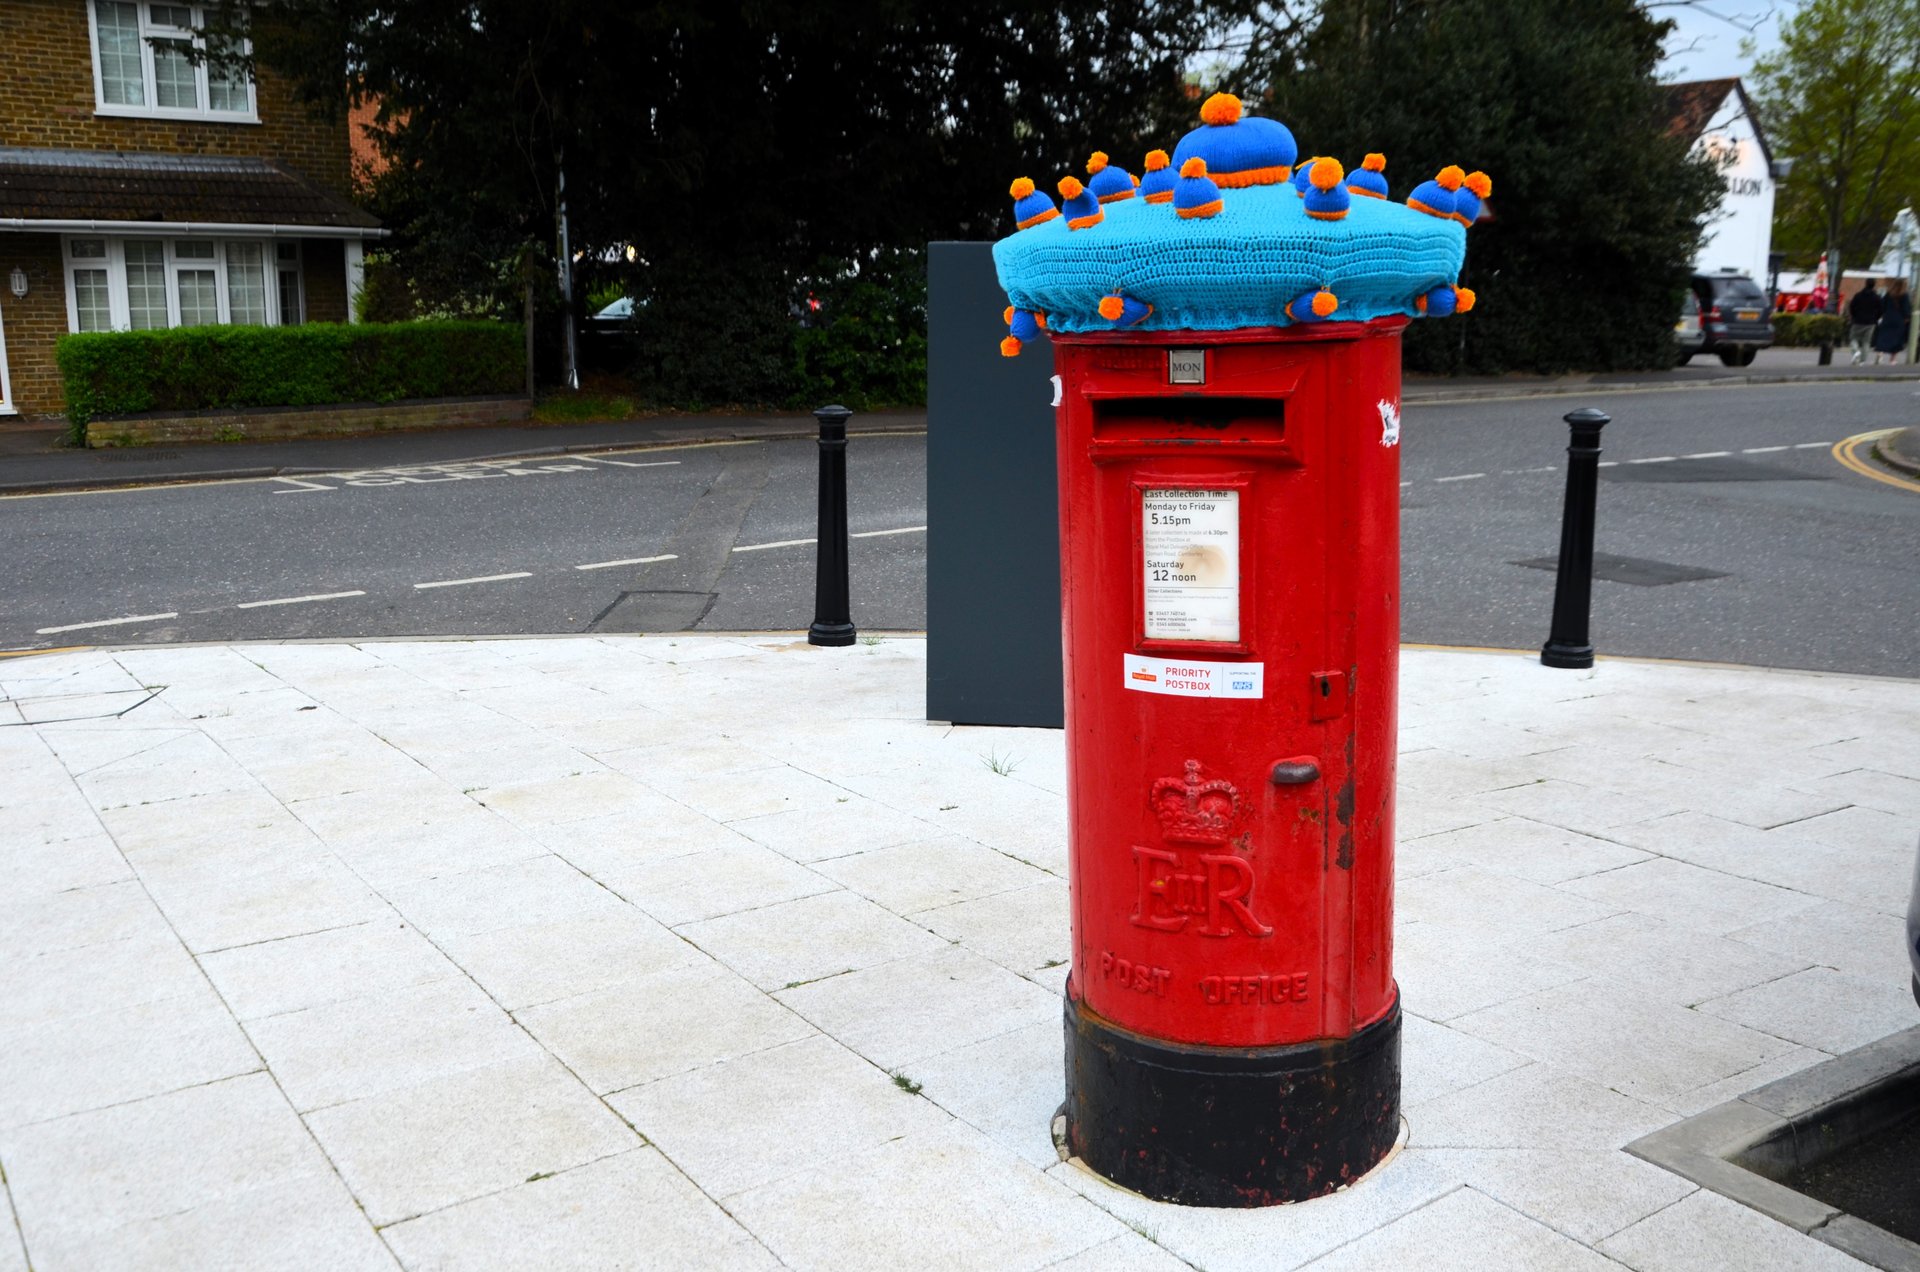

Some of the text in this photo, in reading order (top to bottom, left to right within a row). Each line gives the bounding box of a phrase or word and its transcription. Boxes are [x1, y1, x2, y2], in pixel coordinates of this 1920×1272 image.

[1732, 178, 1762, 196] LION
[1173, 362, 1201, 372] MON
[328, 460, 522, 480] KEEP
[346, 464, 599, 487] CLEAR
[1144, 490, 1228, 498] Last Collection Time
[1145, 502, 1216, 512] Monday to Friday
[1151, 513, 1191, 526] 5.15pm
[1147, 560, 1184, 569] Saturday
[1153, 569, 1197, 582] 12 noon
[1165, 667, 1211, 678] PRIORITY
[1165, 679, 1211, 691] POSTBOX
[1233, 682, 1253, 690] NHS
[1101, 951, 1309, 1005] POST OFFICE
